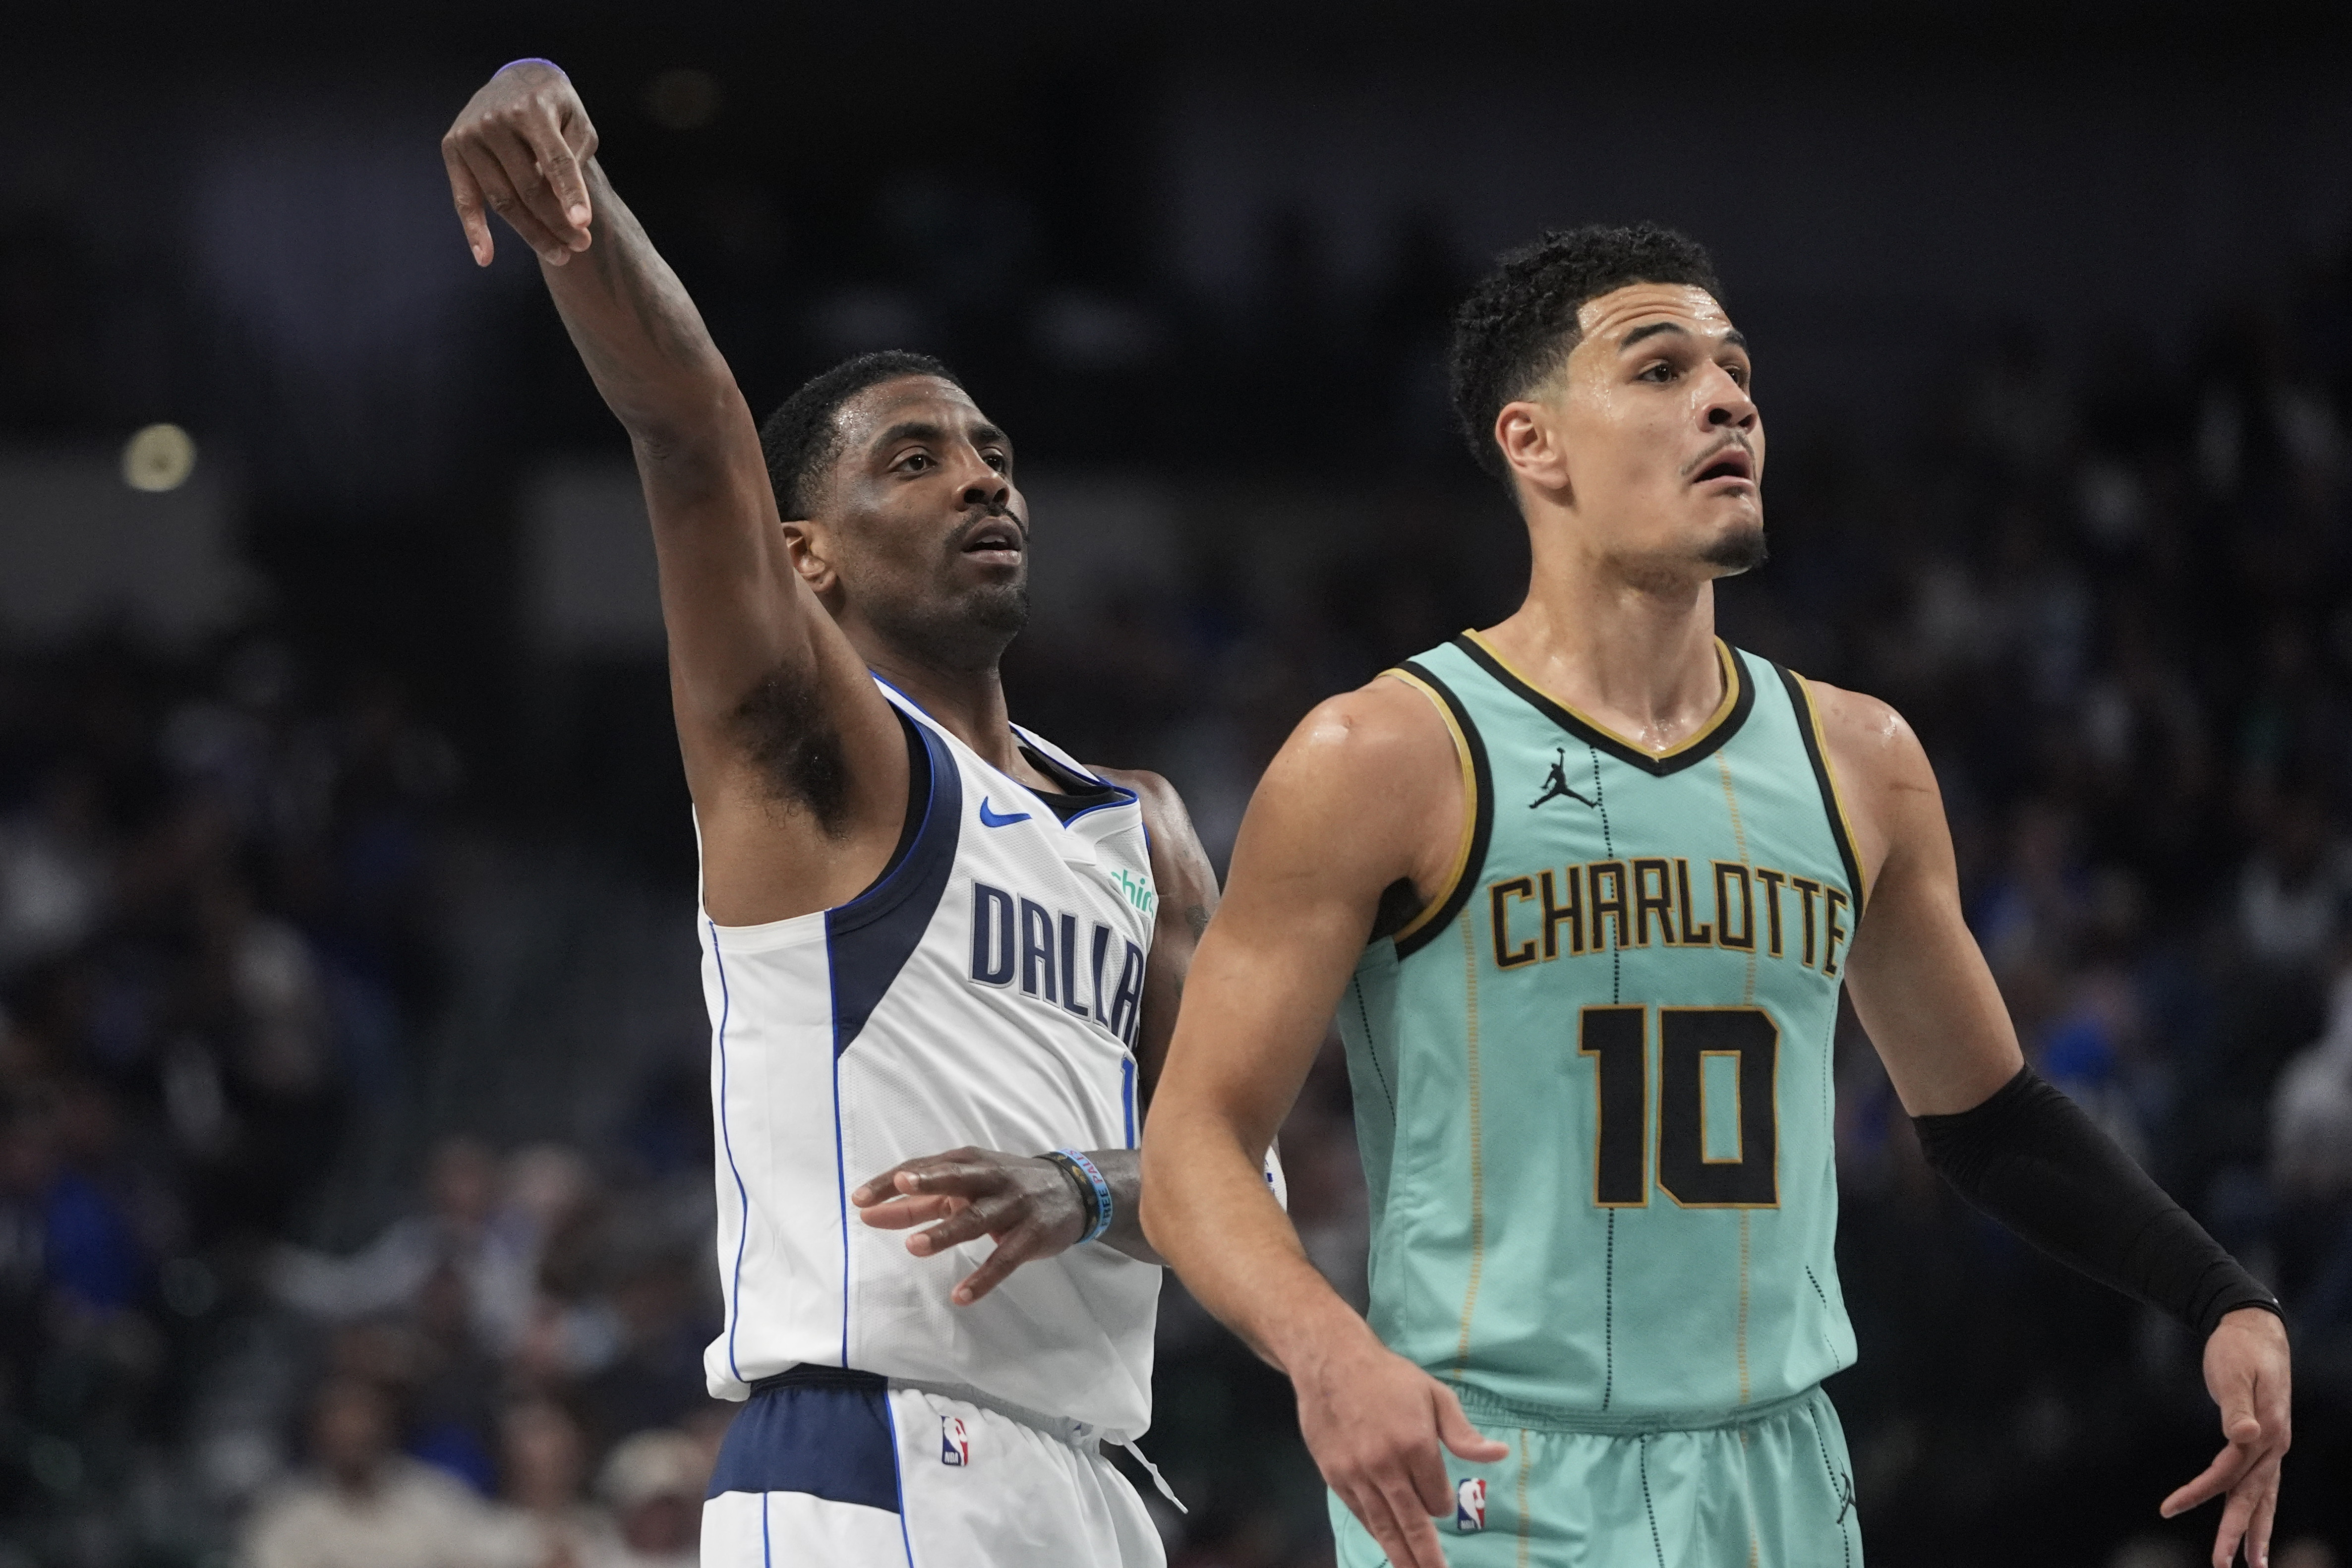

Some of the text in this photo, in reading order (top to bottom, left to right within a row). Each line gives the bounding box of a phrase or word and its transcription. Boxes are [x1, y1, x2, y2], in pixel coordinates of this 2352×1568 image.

[968, 878, 1146, 1051] DALLA
[1488, 857, 1849, 978] CHARLOTTE
[1578, 1003, 1781, 1210] 10
[1062, 1149, 1112, 1227] FREE PALES
[944, 1451, 959, 1464] NBA
